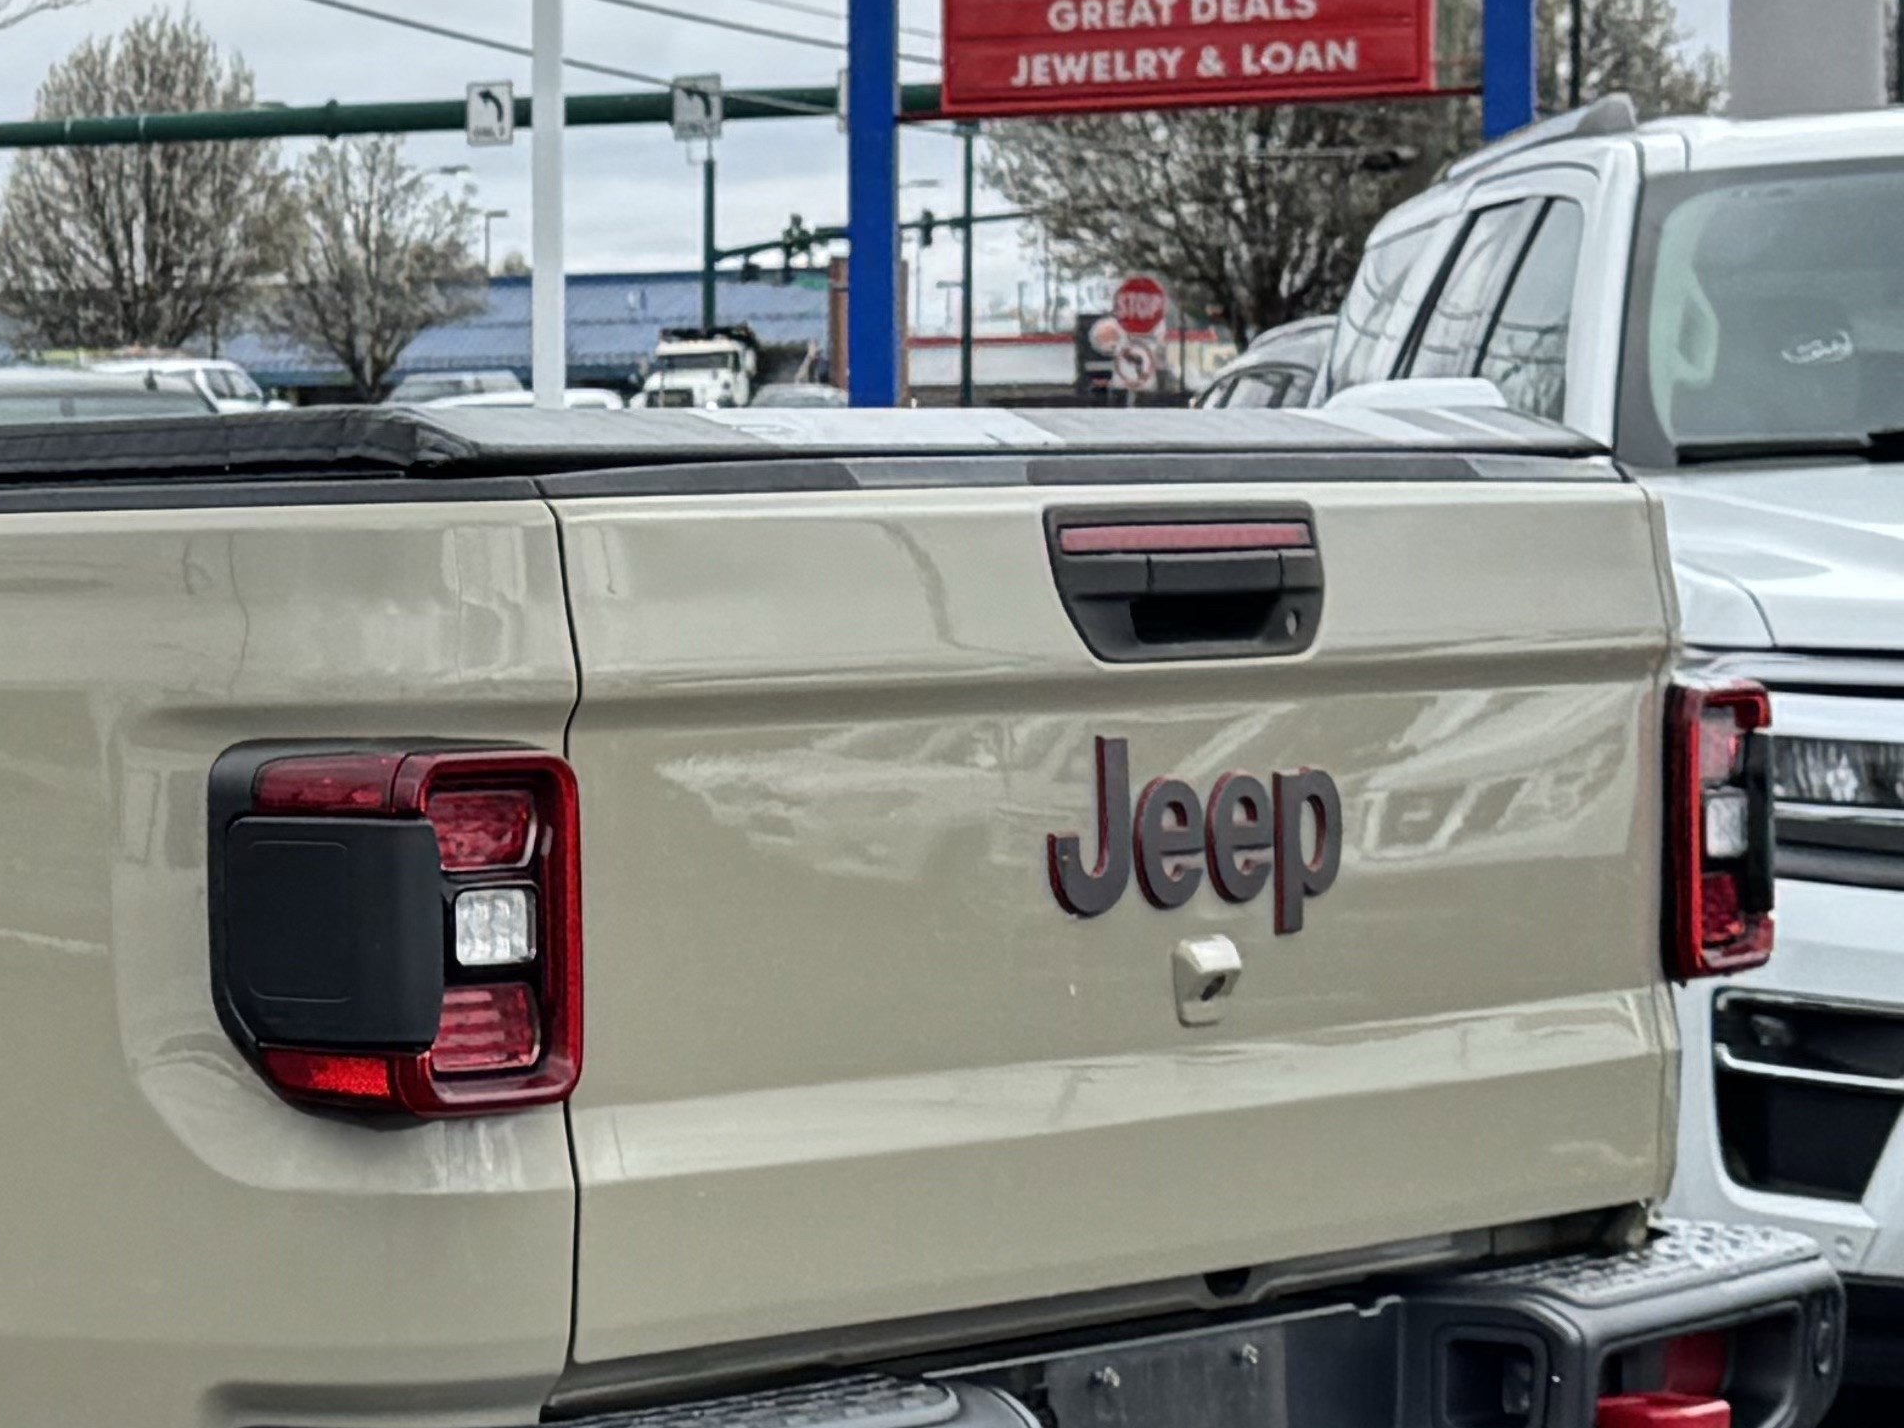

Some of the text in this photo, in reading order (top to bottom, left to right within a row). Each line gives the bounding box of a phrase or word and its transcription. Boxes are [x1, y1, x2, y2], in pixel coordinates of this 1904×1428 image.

[1010, 37, 1359, 88] JEWELRY & LOAN
[1117, 291, 1164, 320] STOP
[1046, 734, 1343, 936] Jeep
